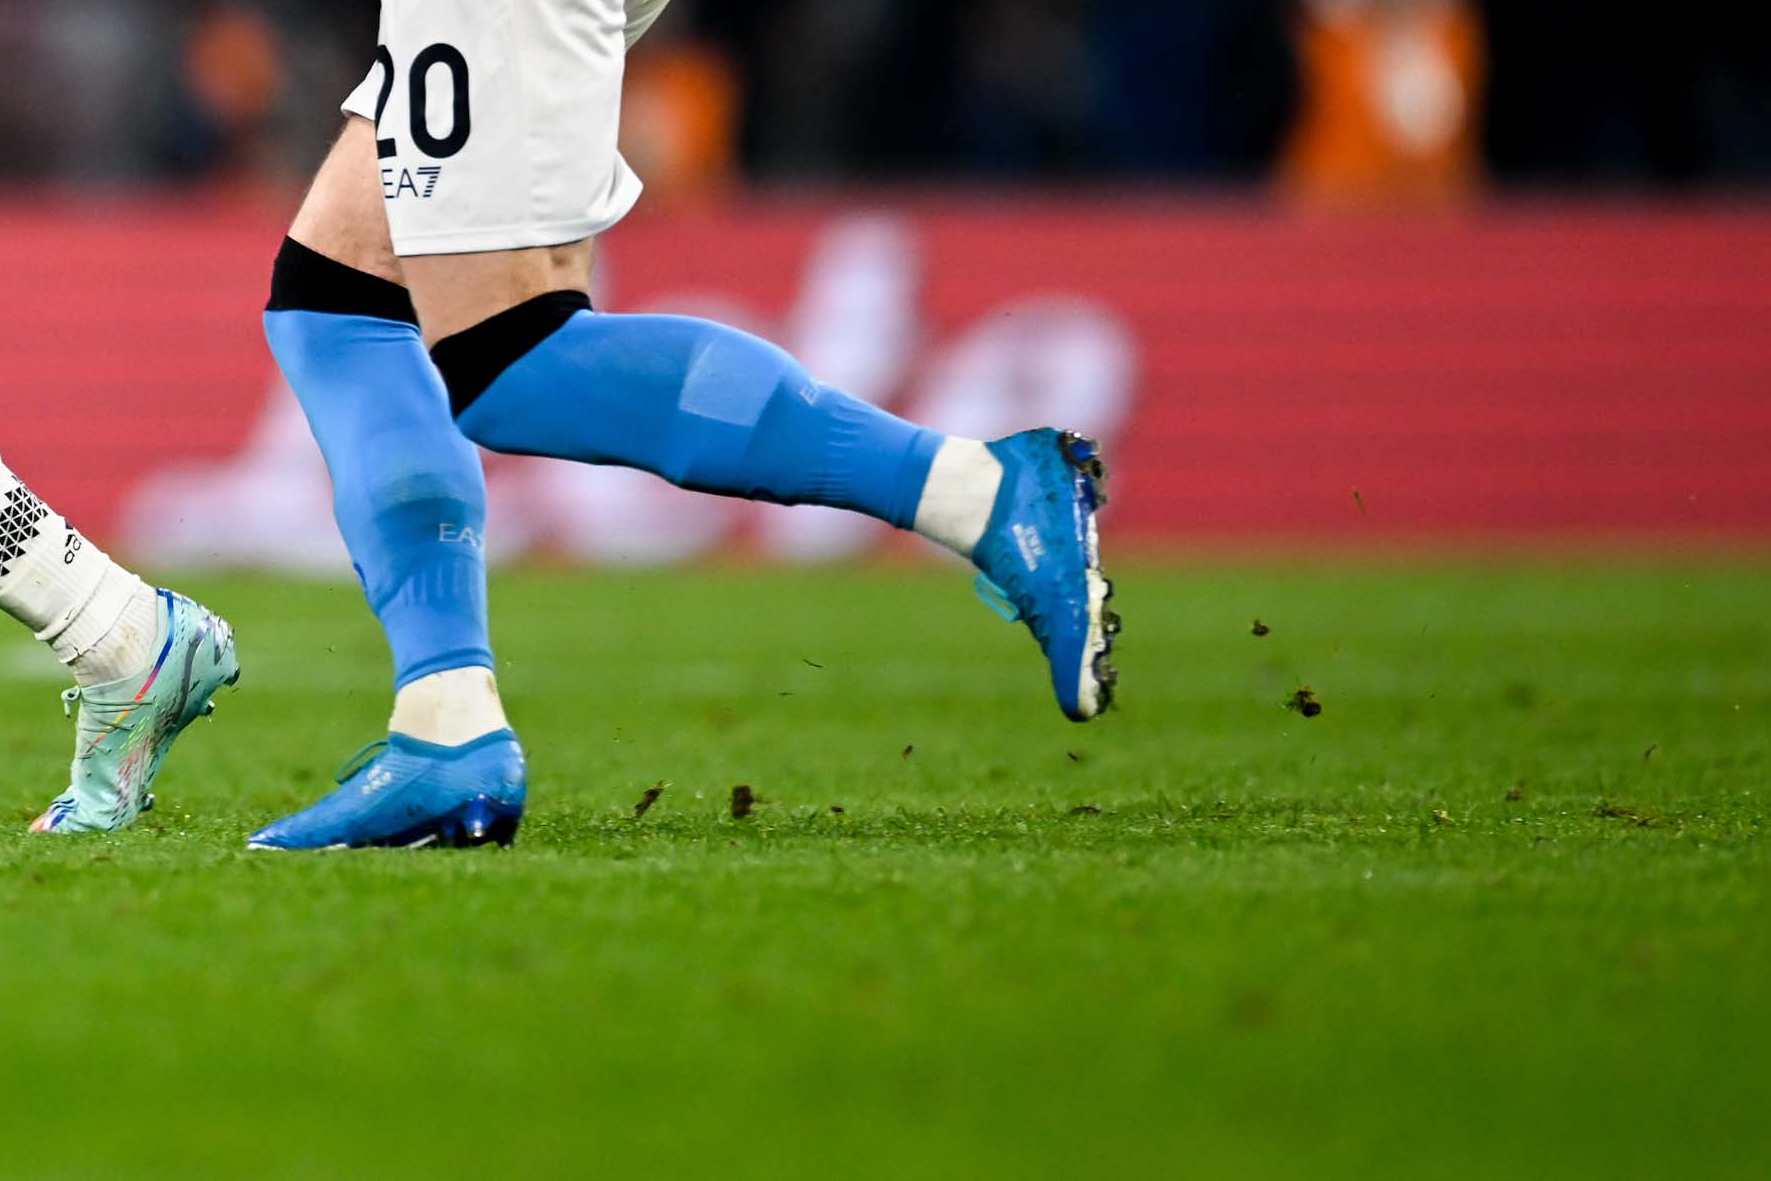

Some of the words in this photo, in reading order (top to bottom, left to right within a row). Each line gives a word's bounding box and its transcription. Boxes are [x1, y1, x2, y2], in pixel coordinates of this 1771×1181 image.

[375, 42, 471, 160] 20
[381, 165, 442, 199] EA7
[439, 522, 484, 548] EA
